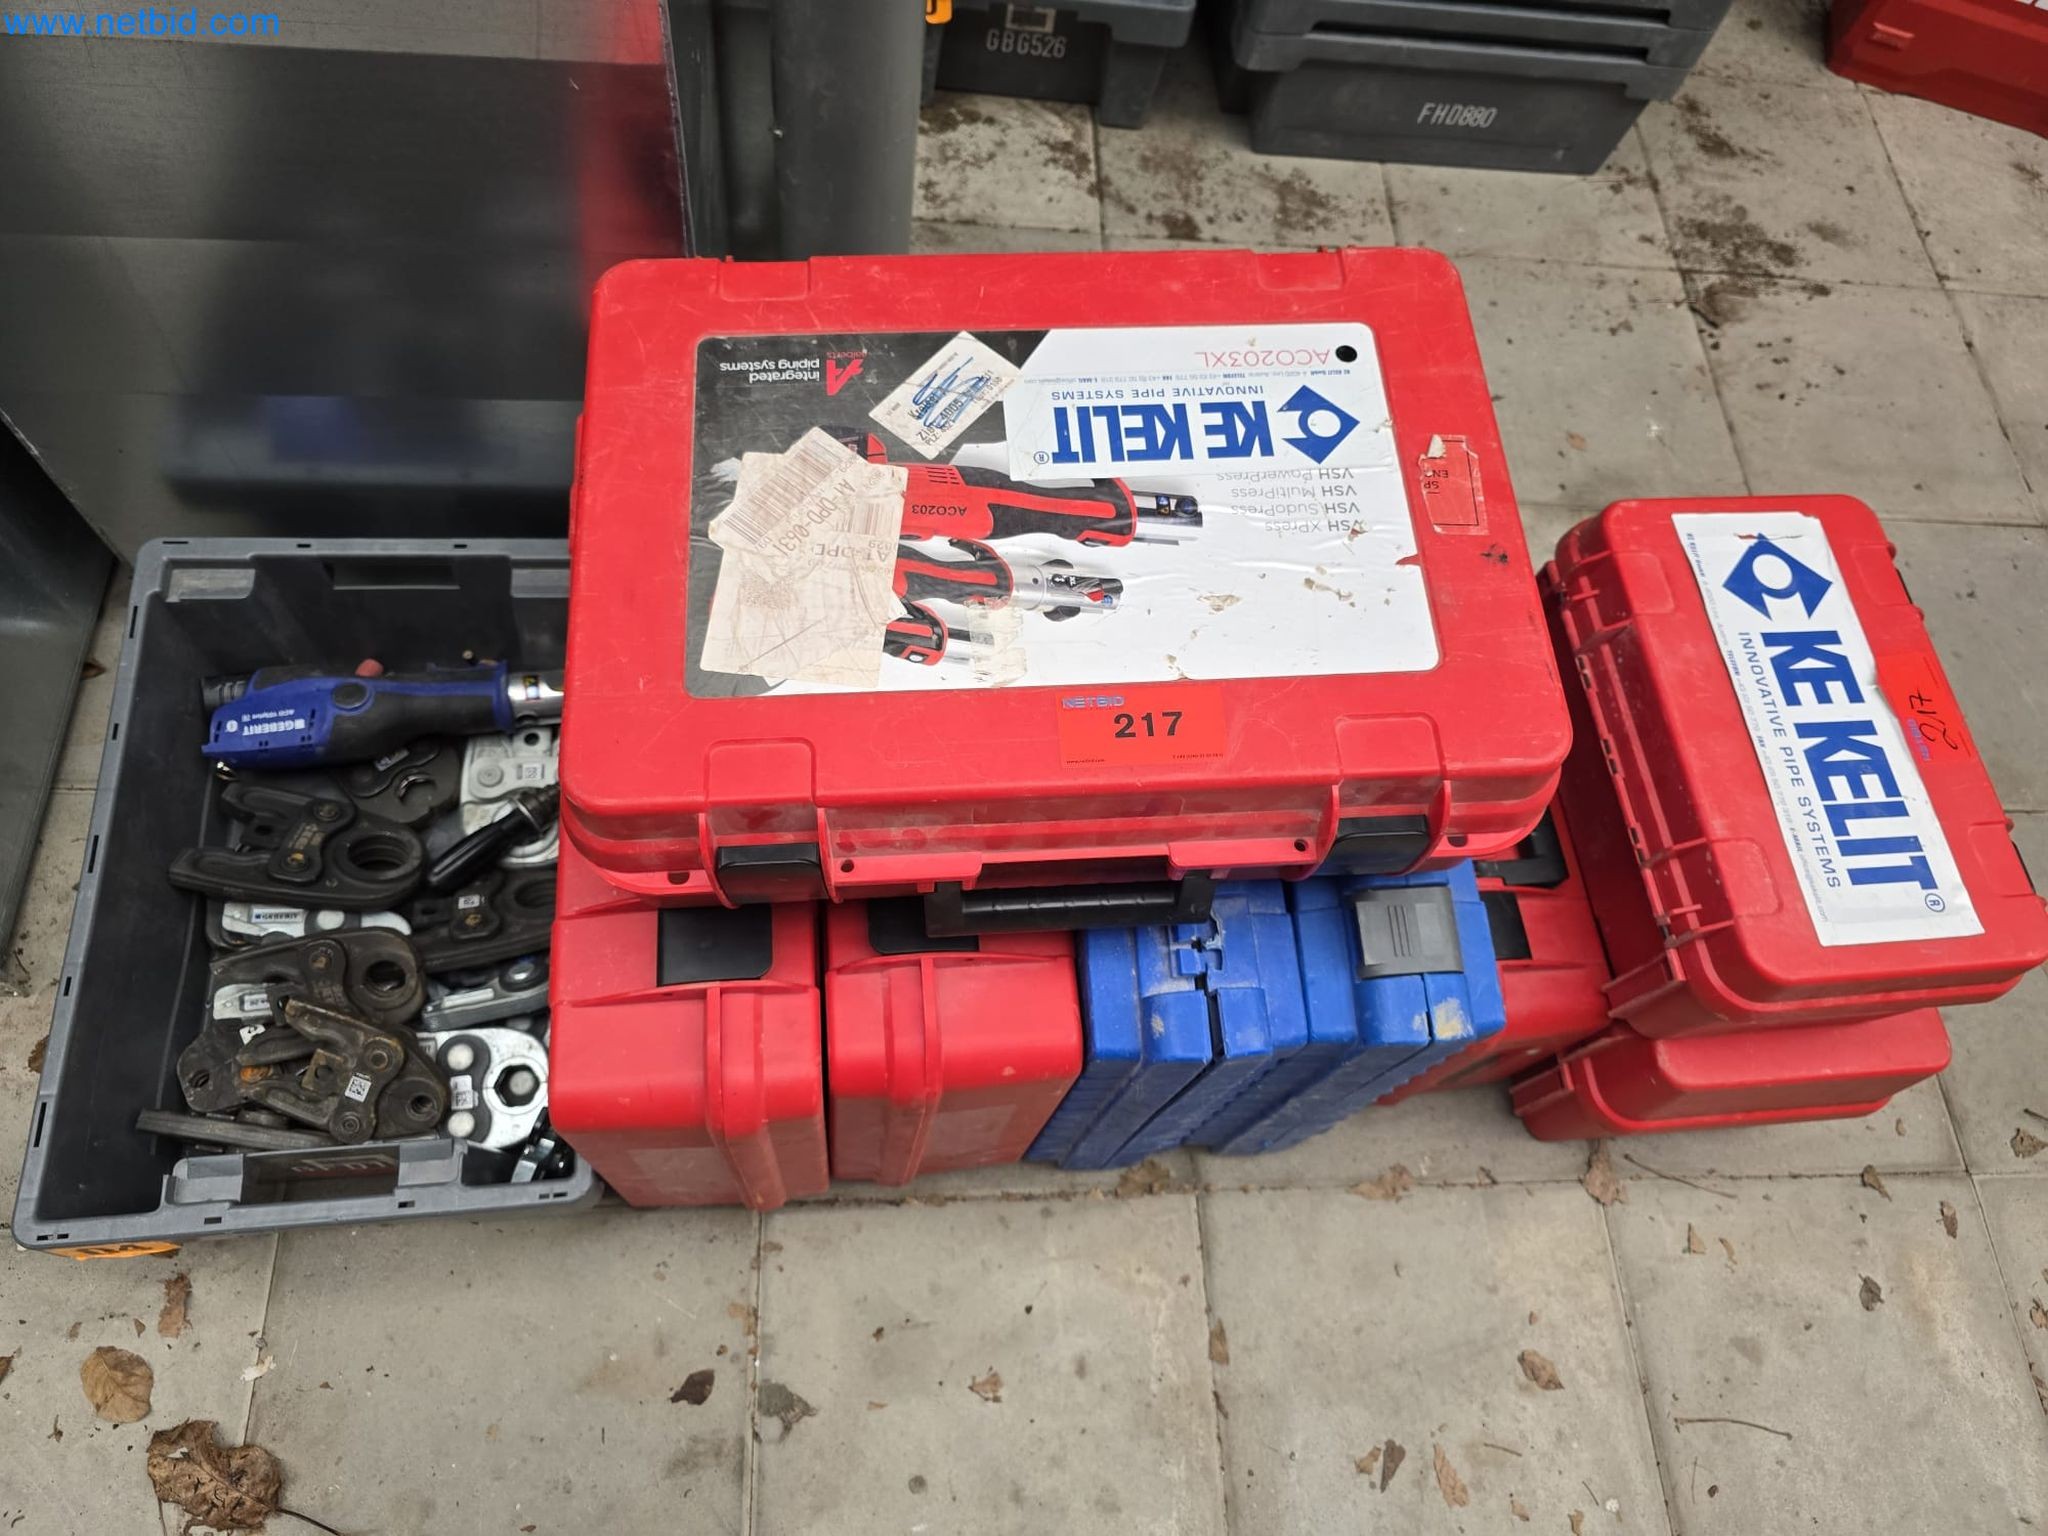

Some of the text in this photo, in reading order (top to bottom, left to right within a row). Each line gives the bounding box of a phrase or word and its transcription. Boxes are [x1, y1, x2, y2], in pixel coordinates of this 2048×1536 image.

[985, 28, 1067, 58] GBG526
[720, 358, 820, 373] piping systems
[1193, 348, 1331, 369] ACO203XL
[749, 370, 820, 384] integrated
[1051, 385, 1264, 401] INNOVATIVE PIPE SYSTEMS
[1199, 400, 1274, 460] KE
[1216, 467, 1353, 483] VSH PowerPress
[1231, 485, 1357, 500] VSH MultiPress
[912, 505, 967, 516] ACO203
[1231, 502, 1360, 517] VSH SudoPress
[1265, 521, 1320, 533] XPress
[1760, 630, 1865, 706] KE
[1062, 695, 1125, 709] NETBID
[1113, 711, 1183, 738] 217
[1909, 687, 1959, 750] 217
[242, 719, 294, 737] GEBERIT
[1738, 631, 1788, 737] INNOVATIVE
[1780, 744, 1805, 788] PIPE
[1797, 795, 1841, 889] SYSTEMS
